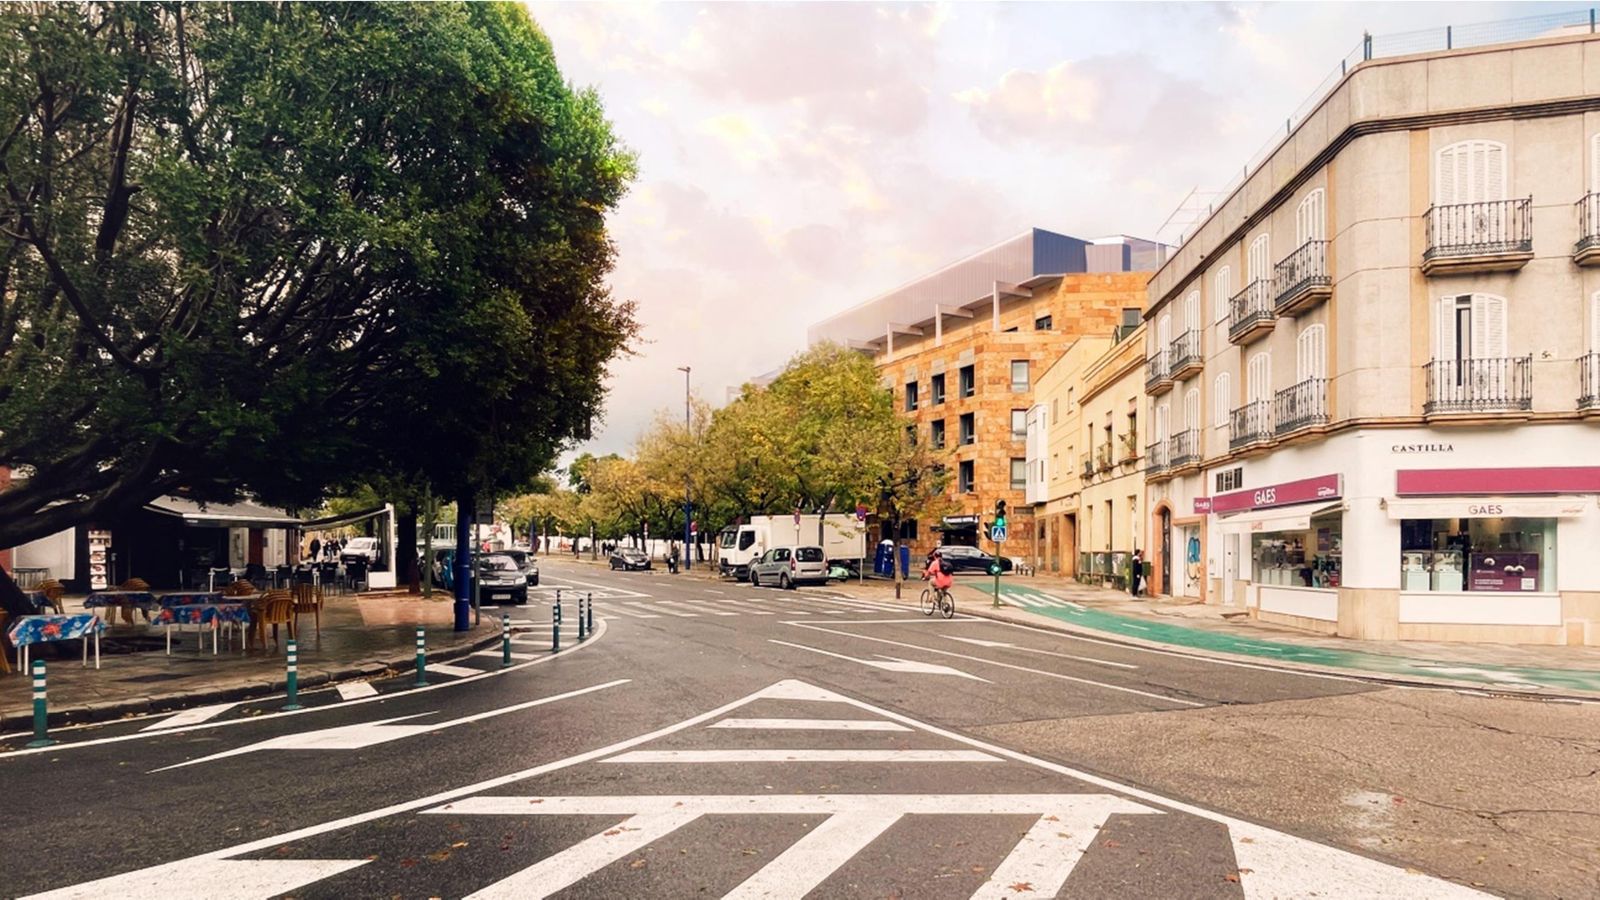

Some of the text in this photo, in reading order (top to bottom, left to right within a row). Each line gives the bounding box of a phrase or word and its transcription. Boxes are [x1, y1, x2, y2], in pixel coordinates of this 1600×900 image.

[1392, 444, 1454, 452] CASTILLA
[1254, 488, 1276, 505] GAES
[1194, 501, 1210, 509] GAES
[1468, 504, 1503, 515] GAES
